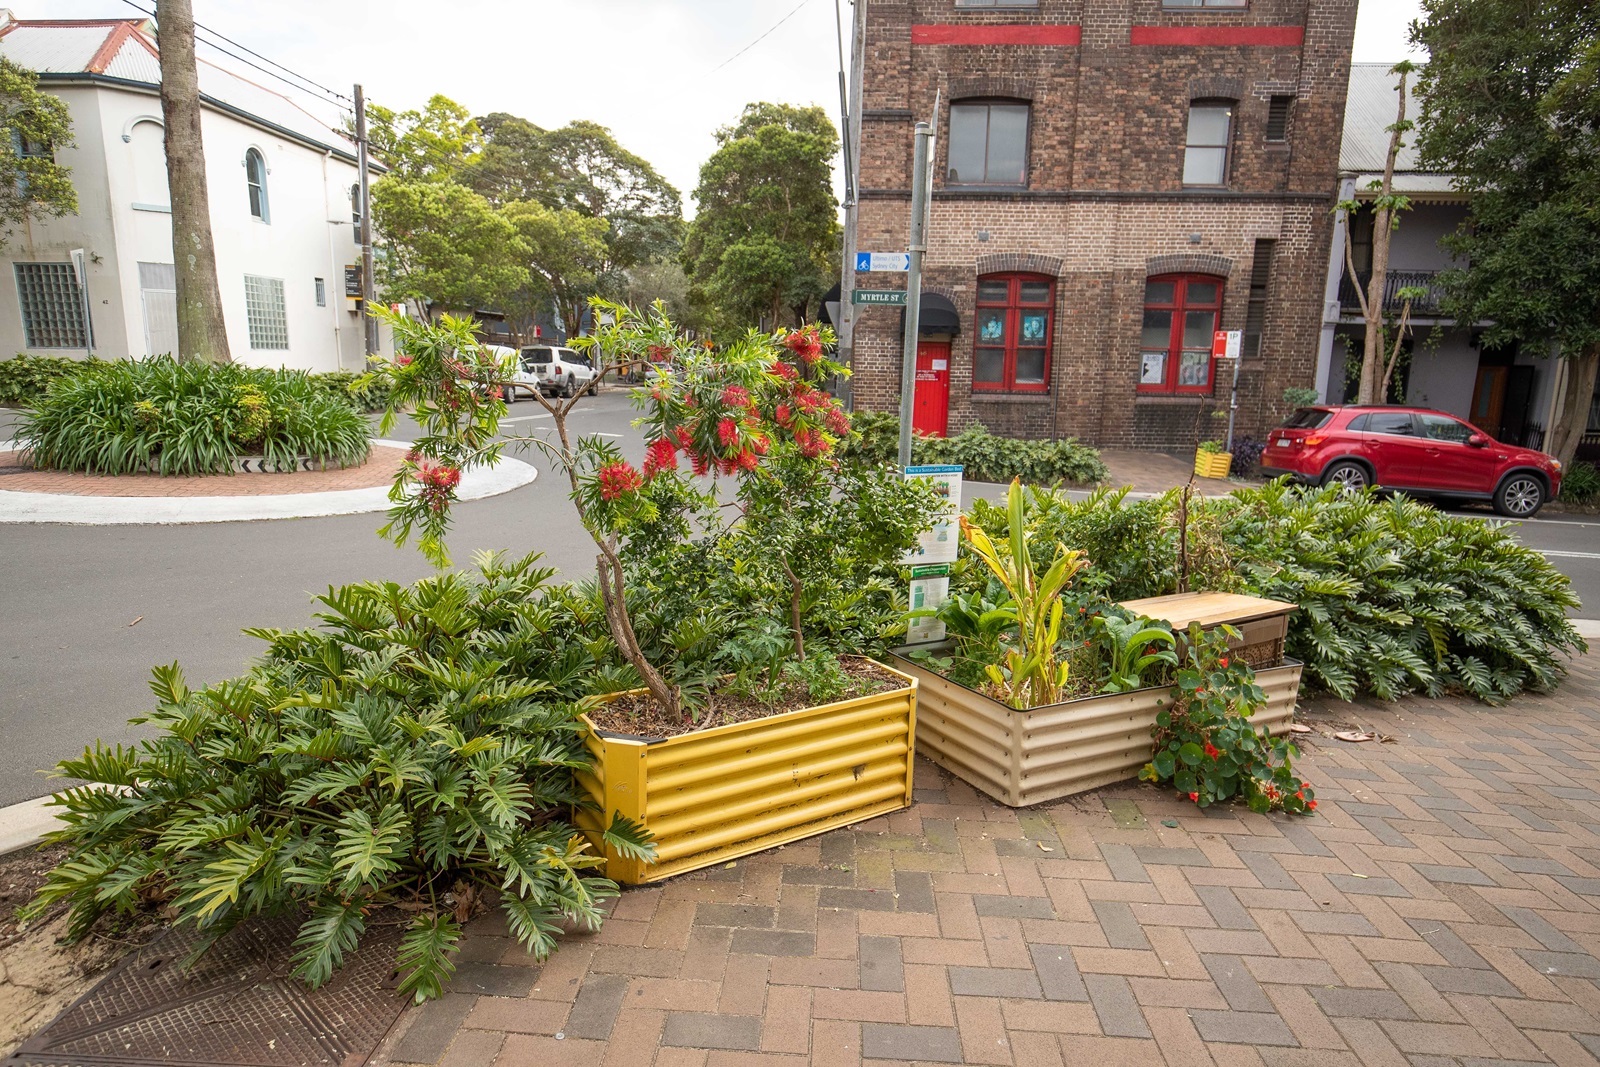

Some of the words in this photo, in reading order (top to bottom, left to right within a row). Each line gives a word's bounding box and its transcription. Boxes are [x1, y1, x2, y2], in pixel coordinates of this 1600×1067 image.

[889, 262, 898, 270] City
[860, 293, 889, 301] MYRTLE
[890, 294, 899, 302] ST
[1229, 332, 1239, 340] 1P
